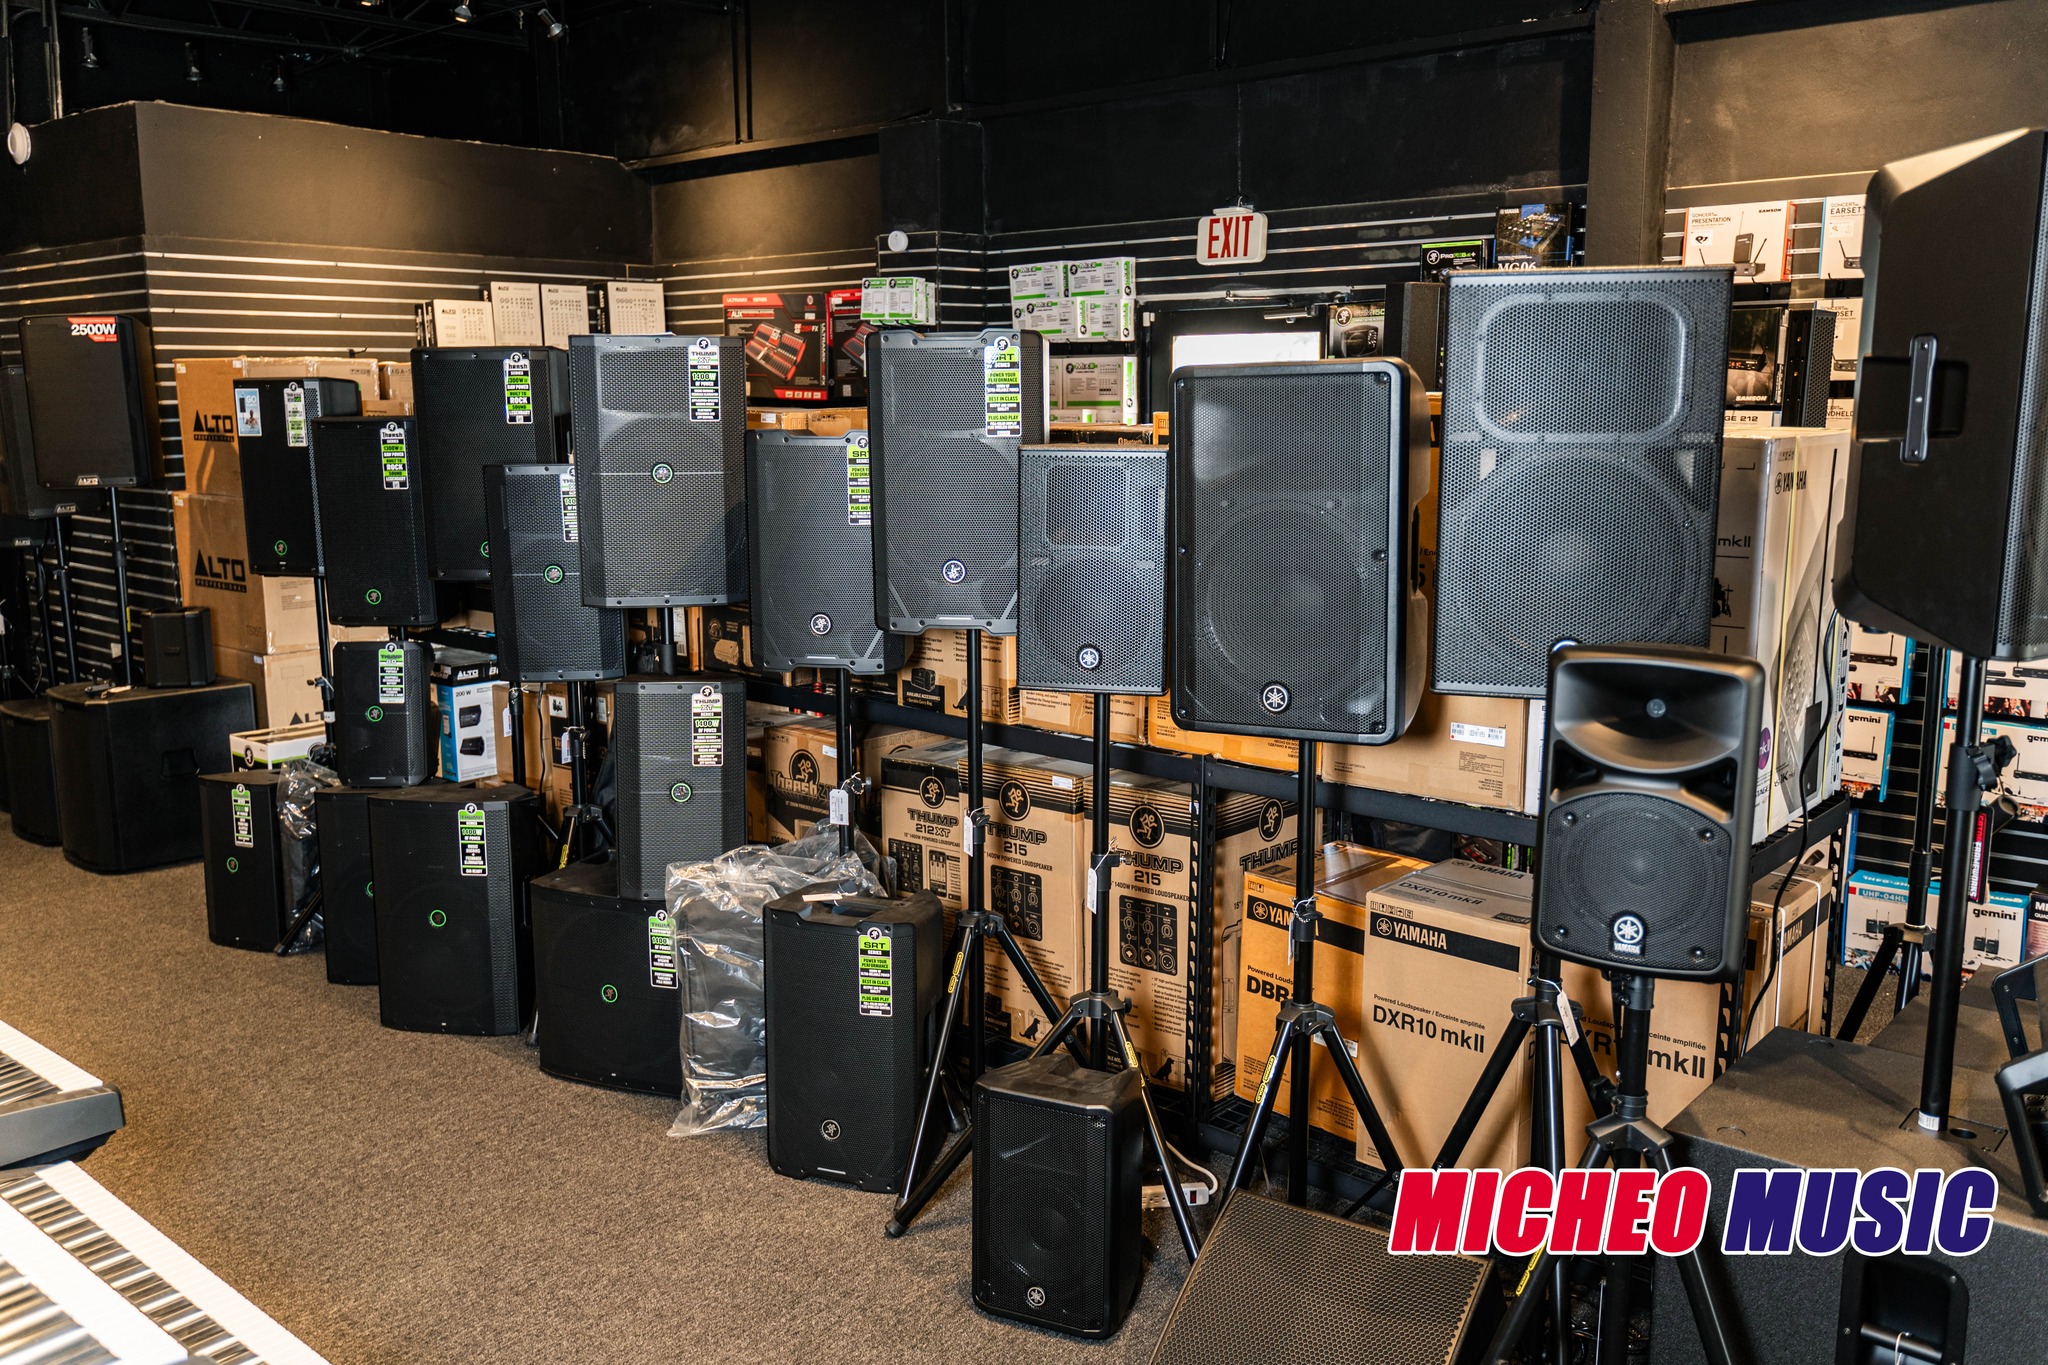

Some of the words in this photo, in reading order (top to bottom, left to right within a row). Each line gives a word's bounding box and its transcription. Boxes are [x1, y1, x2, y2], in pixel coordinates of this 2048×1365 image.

[1831, 207, 1861, 215] EARSET
[1692, 216, 1731, 224] PRESENTATION
[1207, 215, 1254, 259] EXIT
[71, 323, 116, 336] 2500W
[692, 372, 717, 381] 1400W
[193, 410, 234, 434] ALTO
[77, 477, 98, 486] ALTO
[56, 505, 76, 513] ALTO
[1717, 535, 1751, 548] mkII
[195, 549, 246, 583] ALTO
[195, 578, 247, 593] PROFESSIONAL
[457, 669, 478, 680] ALTO
[695, 719, 720, 727] 1400W
[1848, 715, 1881, 724] gemini
[2027, 735, 2048, 743] gem
[907, 808, 959, 827] THUMP
[915, 823, 951, 838] 212XT
[985, 821, 1048, 845] THUMP
[1976, 814, 1986, 842] GATOR
[909, 833, 922, 841] 1400W
[922, 836, 938, 845] POWERED
[938, 839, 960, 848] LOUDSPEAK
[1003, 841, 1028, 857] 215
[986, 853, 1001, 861] 1400W
[1001, 855, 1022, 866] POWERED
[1022, 858, 1053, 872] LOUDSPEAKER
[1969, 841, 1982, 899] FRAMEWORKS
[1134, 869, 1162, 887] 215
[1469, 863, 1525, 880] YAMAHA
[1114, 881, 1130, 891] 1400W
[1130, 884, 1154, 895] POWERED
[1154, 889, 1189, 902] LOUDSPEAKER
[1399, 881, 1448, 898] DXR10
[1449, 894, 1486, 906] mkII
[1862, 889, 1906, 903] UHF-04HL
[1269, 905, 1294, 926] YAM
[1973, 908, 2017, 921] gemini
[1393, 921, 1447, 950] YAMAHA
[864, 941, 886, 949] SRT
[1613, 942, 1641, 955] YAMAHA
[862, 962, 889, 970] PERFORMANCE
[1247, 965, 1274, 980] Powered
[1373, 993, 1396, 1005] Powered
[1397, 999, 1431, 1015] Loudspeaker
[1435, 1011, 1459, 1023] Enceinte
[1459, 1018, 1486, 1030] amplifiée
[1373, 1004, 1437, 1039] DXR10
[1440, 1027, 1485, 1053] mkII
[1648, 1031, 1671, 1043] ceinte
[1672, 1038, 1707, 1051] amplifiée
[1647, 1048, 1706, 1079] mkII
